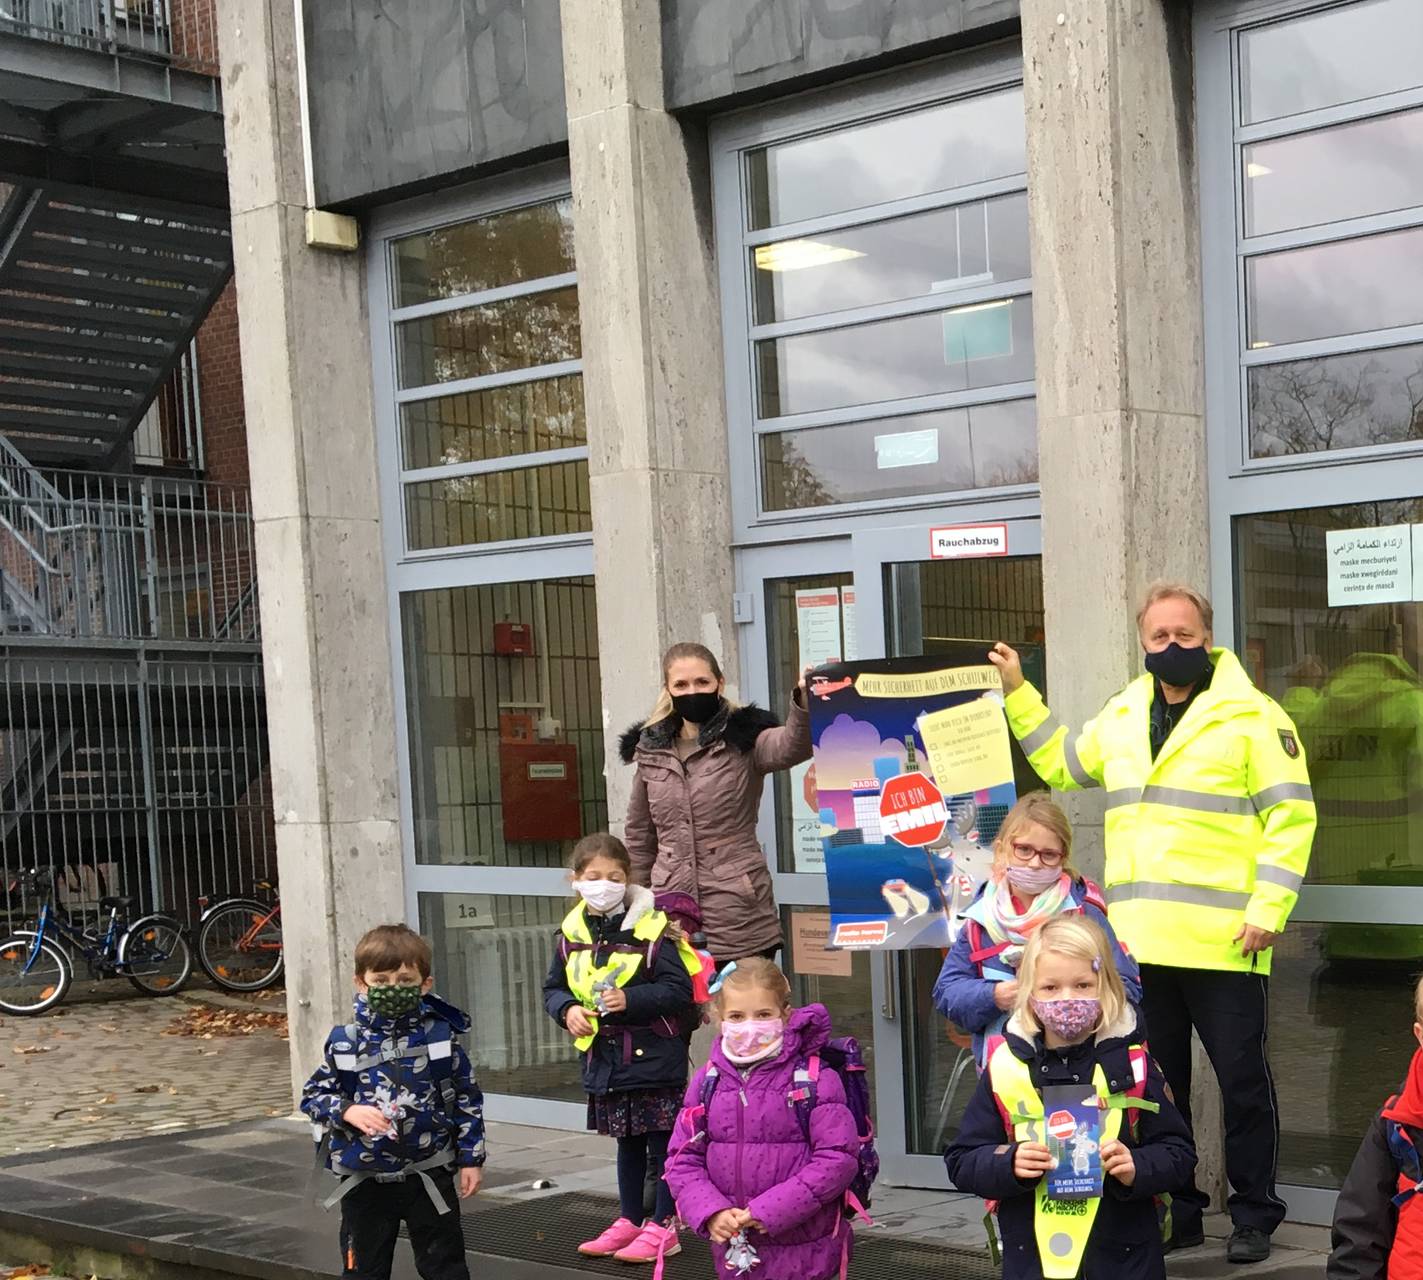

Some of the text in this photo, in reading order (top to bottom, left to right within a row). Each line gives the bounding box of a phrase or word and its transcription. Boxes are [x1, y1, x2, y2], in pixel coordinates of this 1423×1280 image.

[938, 537, 999, 548] Rauchabzug
[924, 677, 938, 691] AUF
[939, 673, 956, 689] DEM
[957, 670, 999, 687] SCHULWEG
[852, 780, 879, 788] RADIO
[890, 786, 927, 810] ICH BIN
[880, 801, 952, 835] EMIL
[459, 903, 477, 919] 1a
